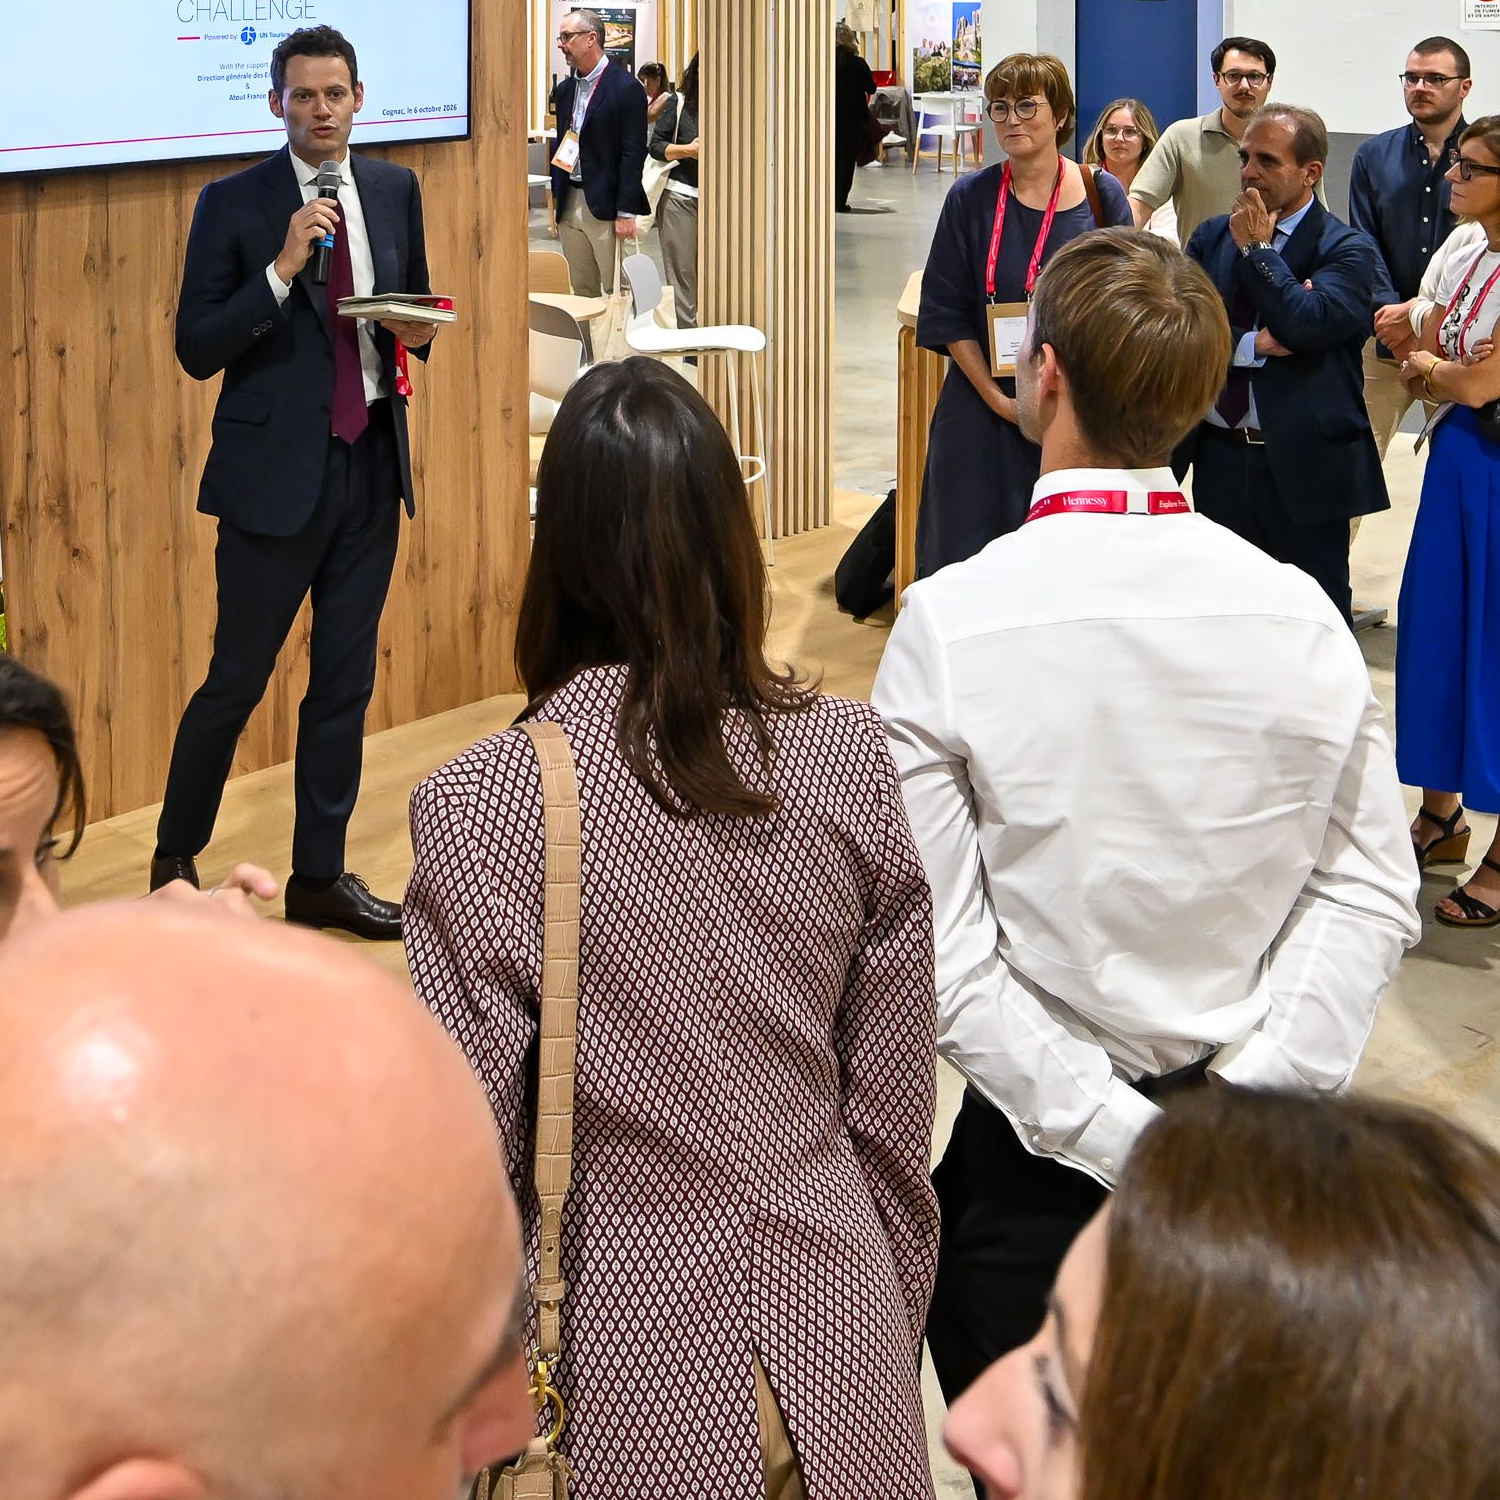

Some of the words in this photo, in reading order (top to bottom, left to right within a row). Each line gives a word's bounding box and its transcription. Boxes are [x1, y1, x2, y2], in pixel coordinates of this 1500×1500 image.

[204, 33, 229, 41] Powered
[220, 62, 234, 70] With
[235, 62, 245, 70] the
[246, 62, 269, 71] support
[197, 74, 225, 82] Direction
[226, 72, 252, 82] générale
[253, 71, 264, 80] des
[382, 107, 406, 118] Cognac,
[407, 107, 412, 115] le
[419, 104, 443, 114] octobre
[444, 103, 458, 113] 2026
[1063, 496, 1108, 507] Hennessy
